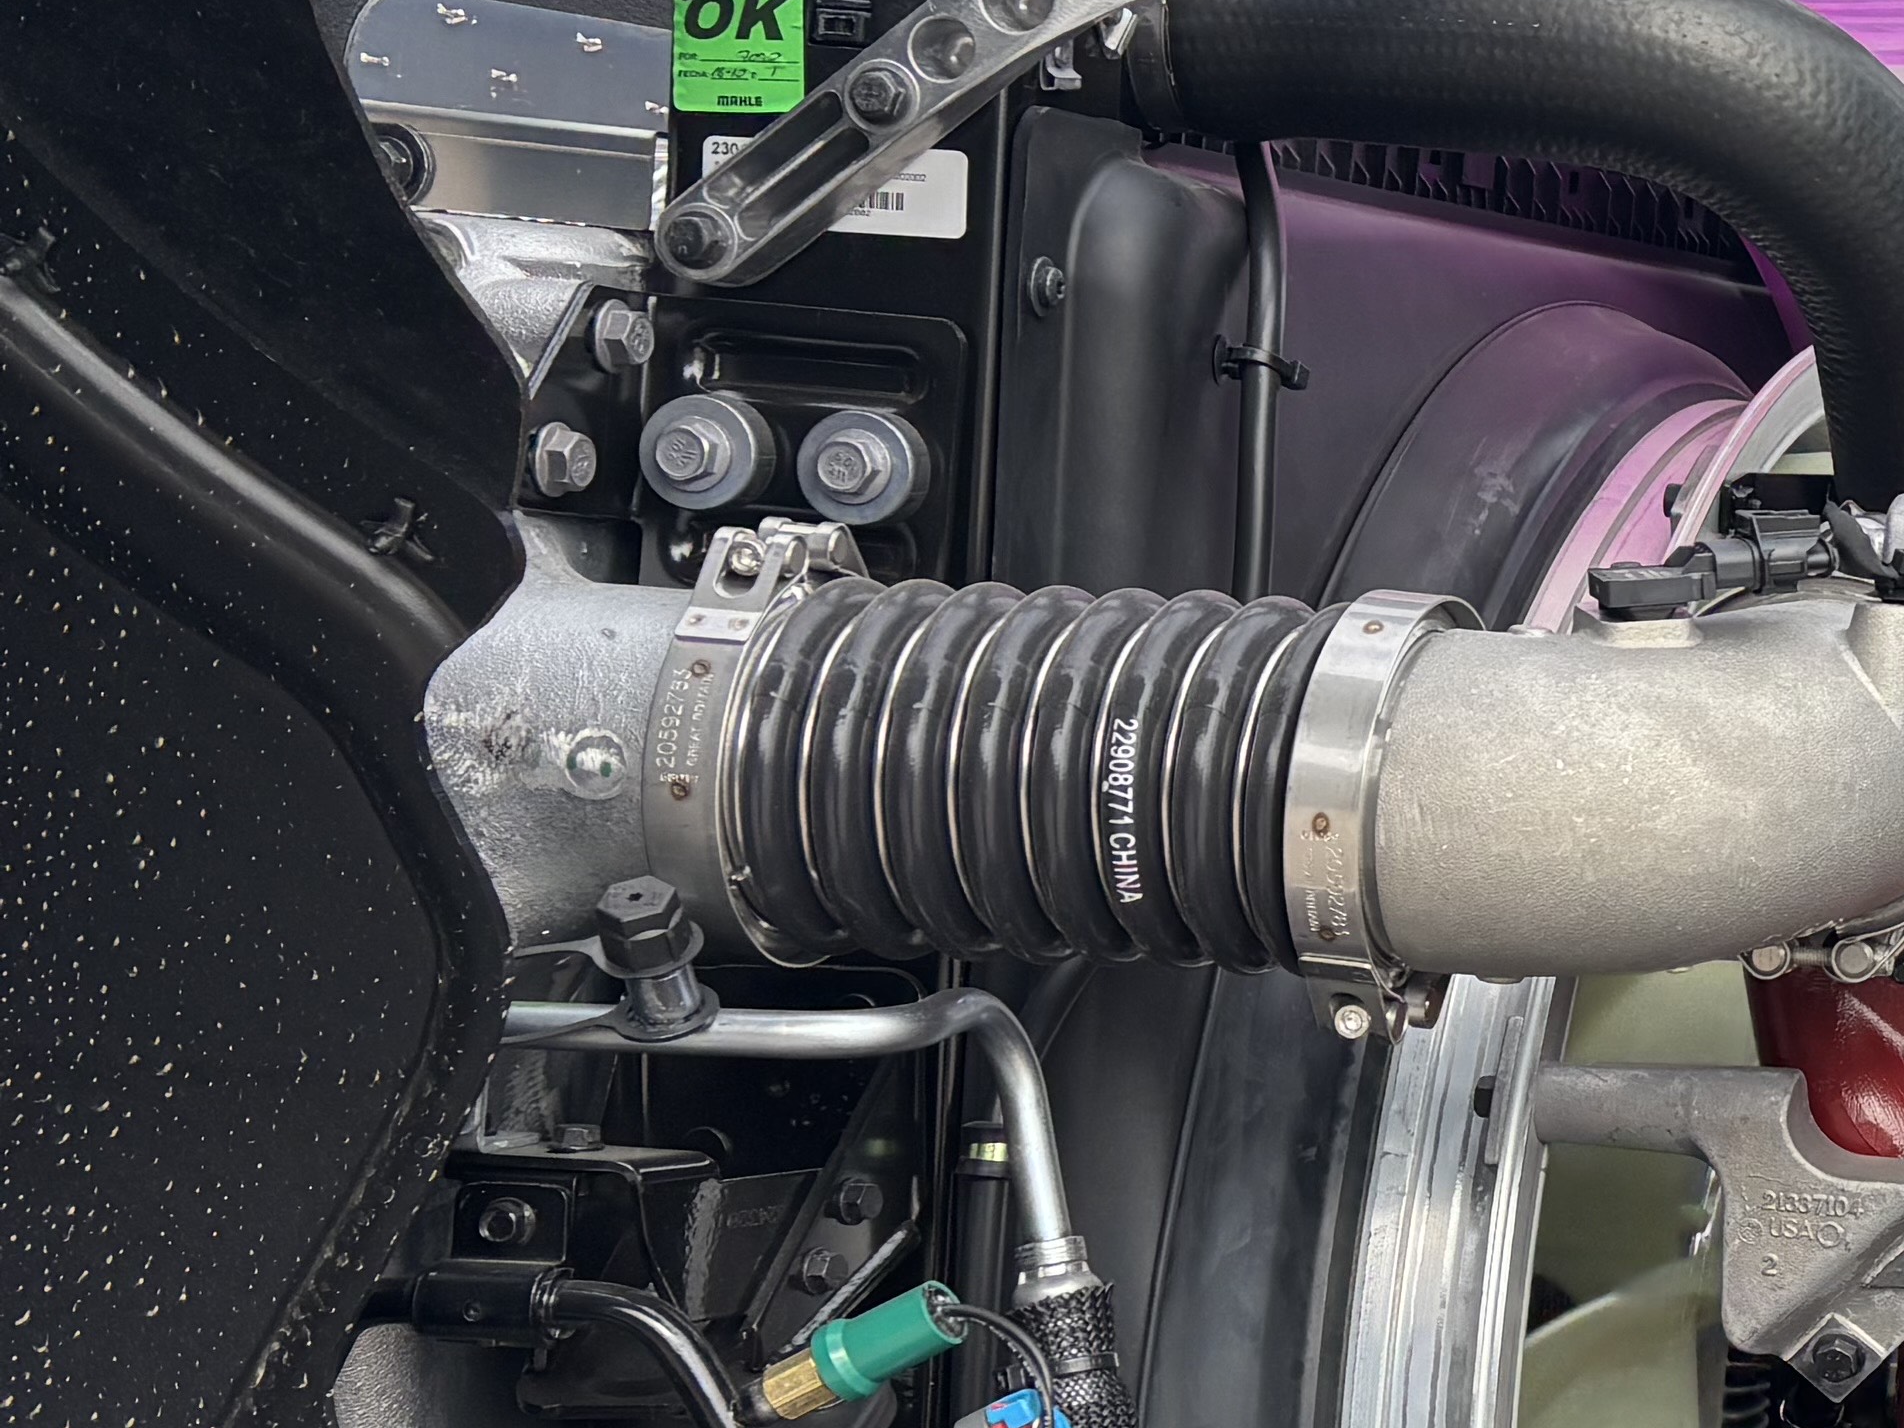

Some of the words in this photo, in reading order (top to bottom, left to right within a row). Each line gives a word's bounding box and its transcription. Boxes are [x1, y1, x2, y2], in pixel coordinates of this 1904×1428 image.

[717, 96, 763, 106] MAHLE
[1106, 717, 1140, 825] 22908771
[1108, 831, 1144, 905] CHINA
[1770, 1217, 1814, 1240] USA
[1760, 1253, 1779, 1276] 2
